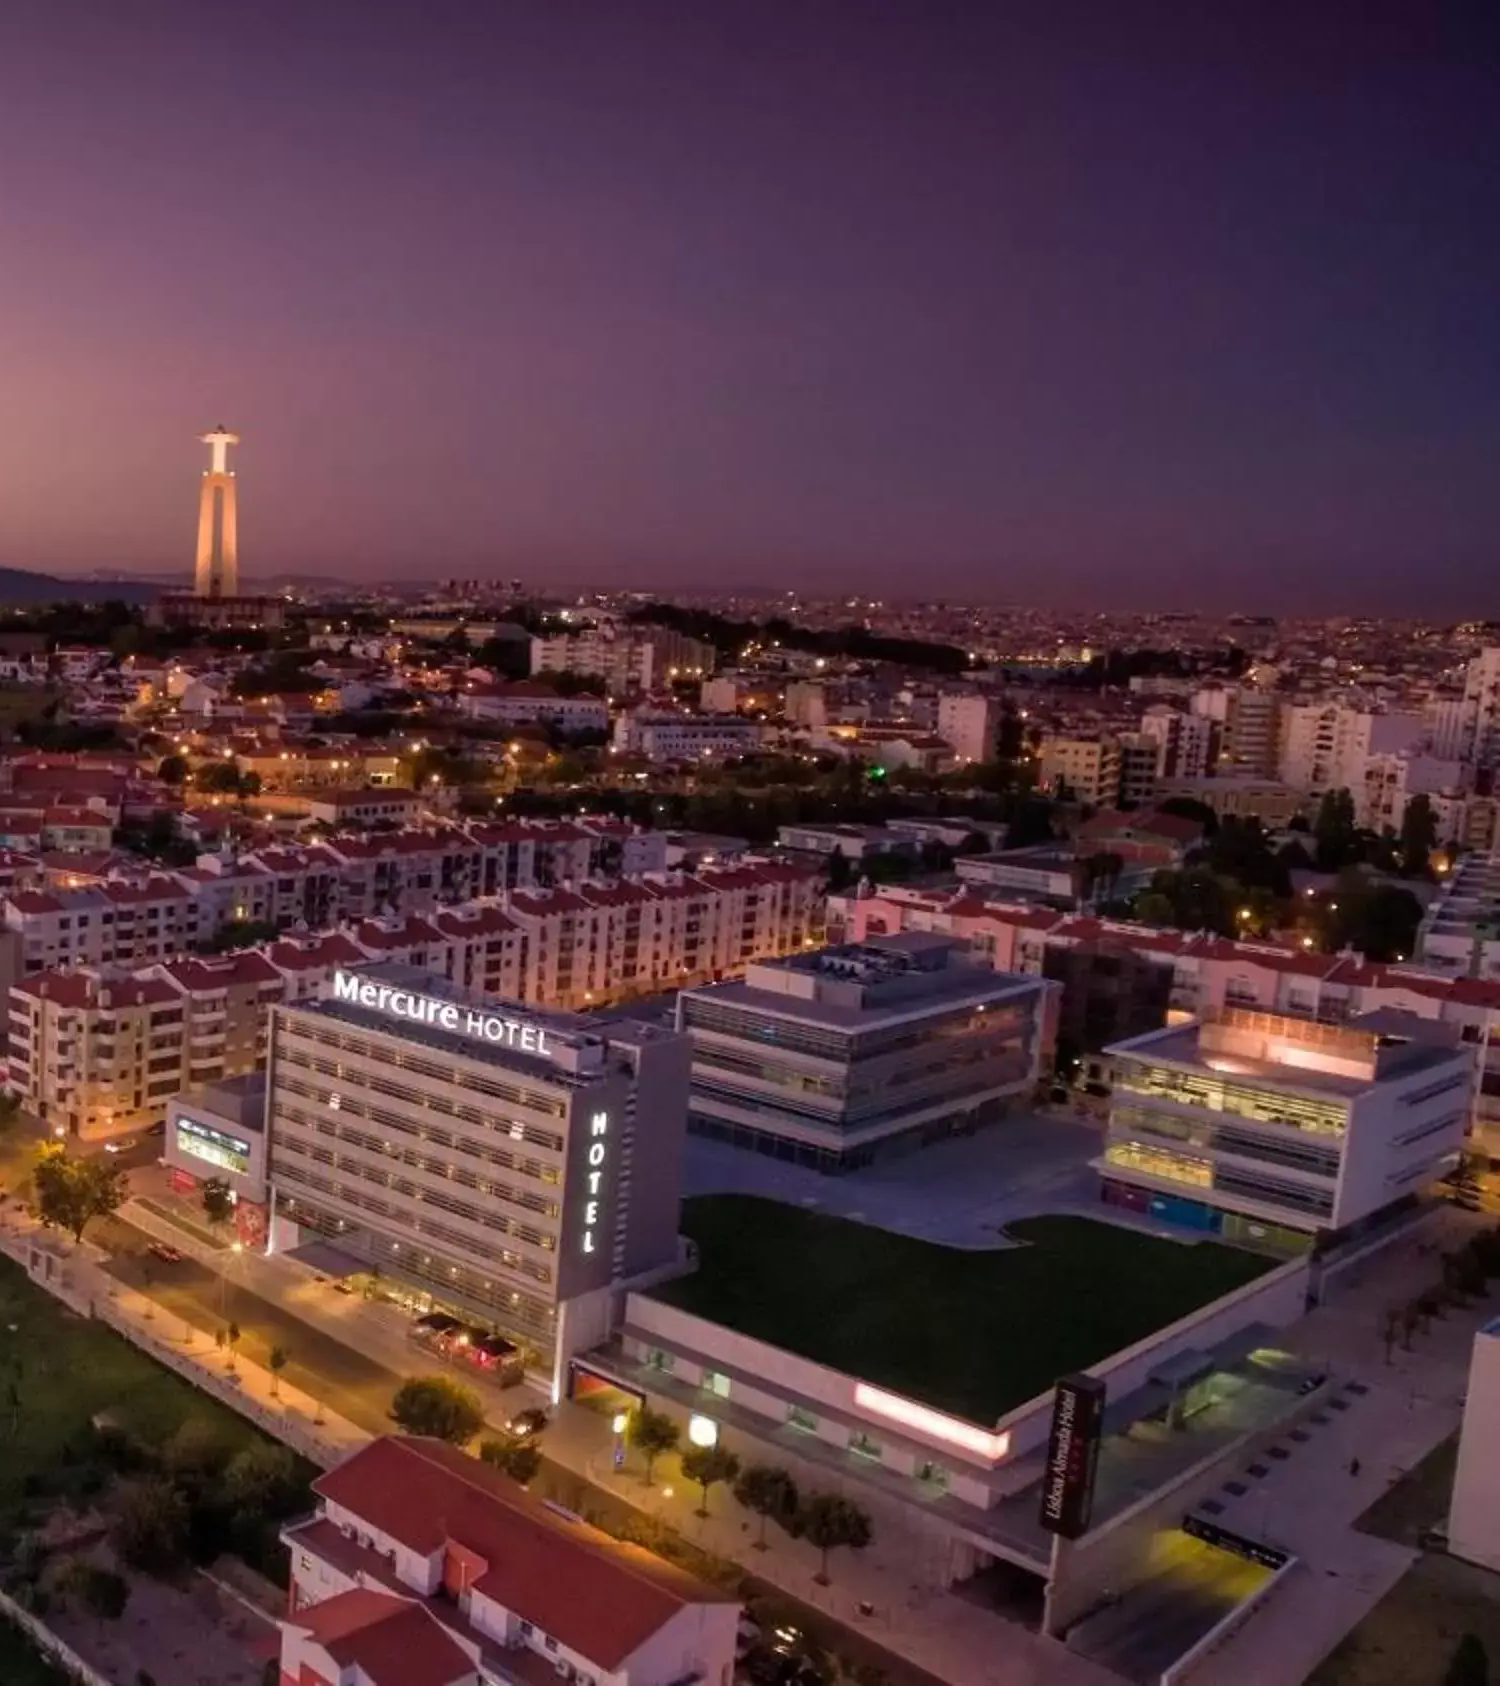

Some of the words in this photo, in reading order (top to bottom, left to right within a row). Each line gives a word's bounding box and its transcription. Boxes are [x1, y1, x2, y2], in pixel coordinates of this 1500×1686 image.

[334, 970, 459, 1029] Mercure
[466, 1011, 551, 1055] HOTEL
[583, 1112, 607, 1253] HOTEL
[1046, 1478, 1065, 1519] Lisboa
[1061, 1390, 1077, 1428] Hotel
